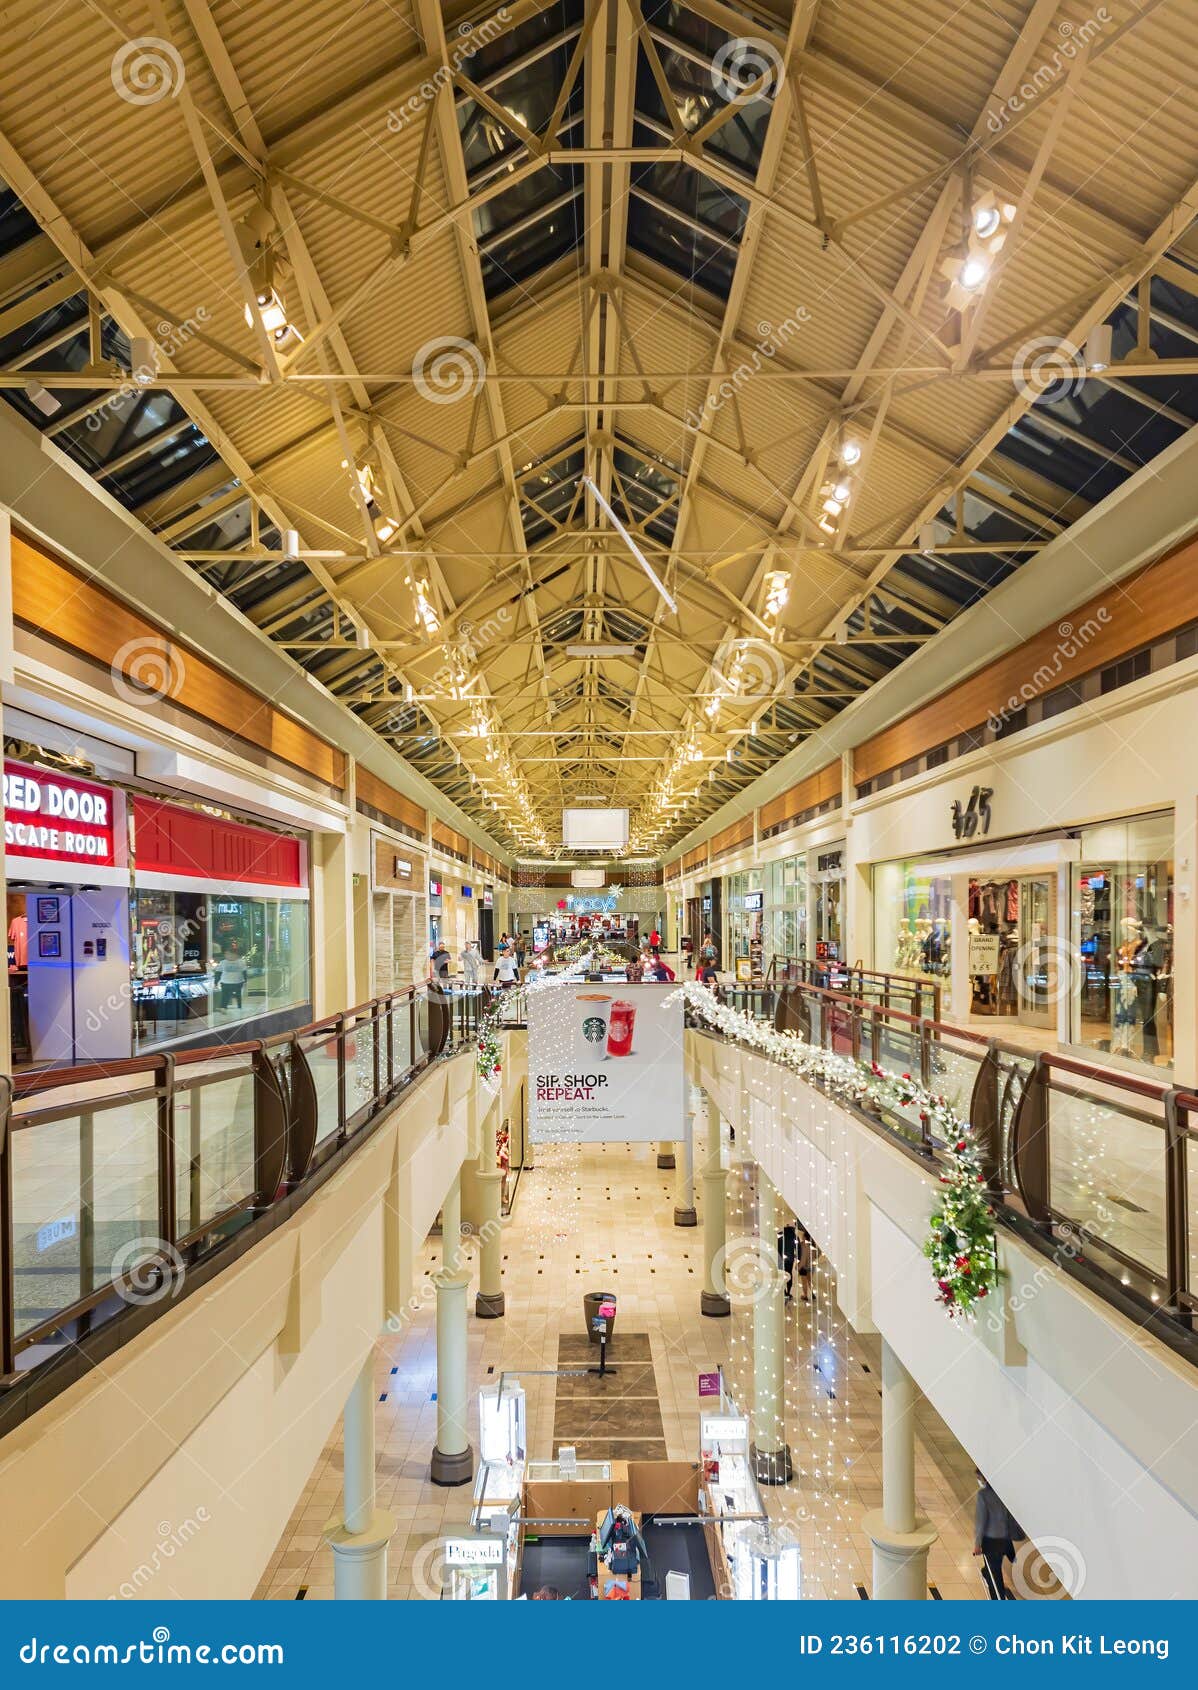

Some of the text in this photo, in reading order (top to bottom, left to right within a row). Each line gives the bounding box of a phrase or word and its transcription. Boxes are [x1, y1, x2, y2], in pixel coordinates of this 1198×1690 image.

[48, 784, 107, 826] DOOR
[5, 821, 108, 857] SCAPE ROOM
[536, 1075, 608, 1087] SIP. SHOP.
[536, 1087, 595, 1100] REPEAT.
[449, 1545, 499, 1560] Pagoda
